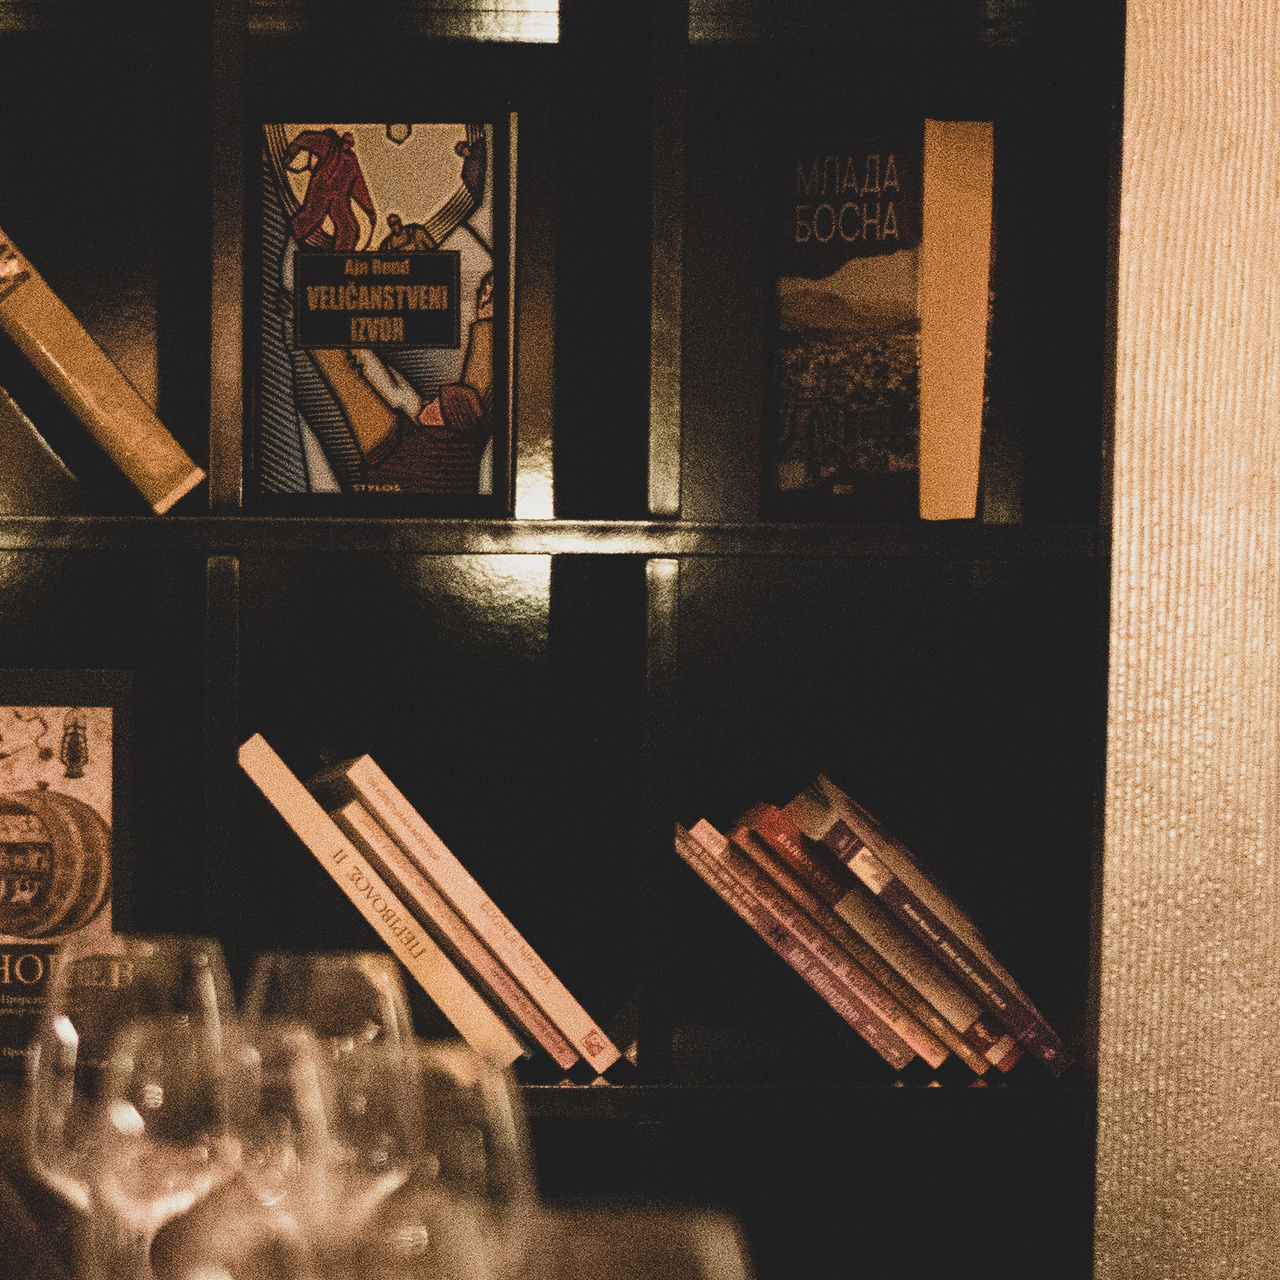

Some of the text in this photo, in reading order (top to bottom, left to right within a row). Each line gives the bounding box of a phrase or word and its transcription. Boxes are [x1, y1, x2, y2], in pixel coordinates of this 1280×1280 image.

[795, 153, 900, 197] МЛАДА
[795, 201, 900, 243] БОСНА
[306, 281, 449, 310] VELIČANSTVENI
[350, 316, 404, 342] IZVOR
